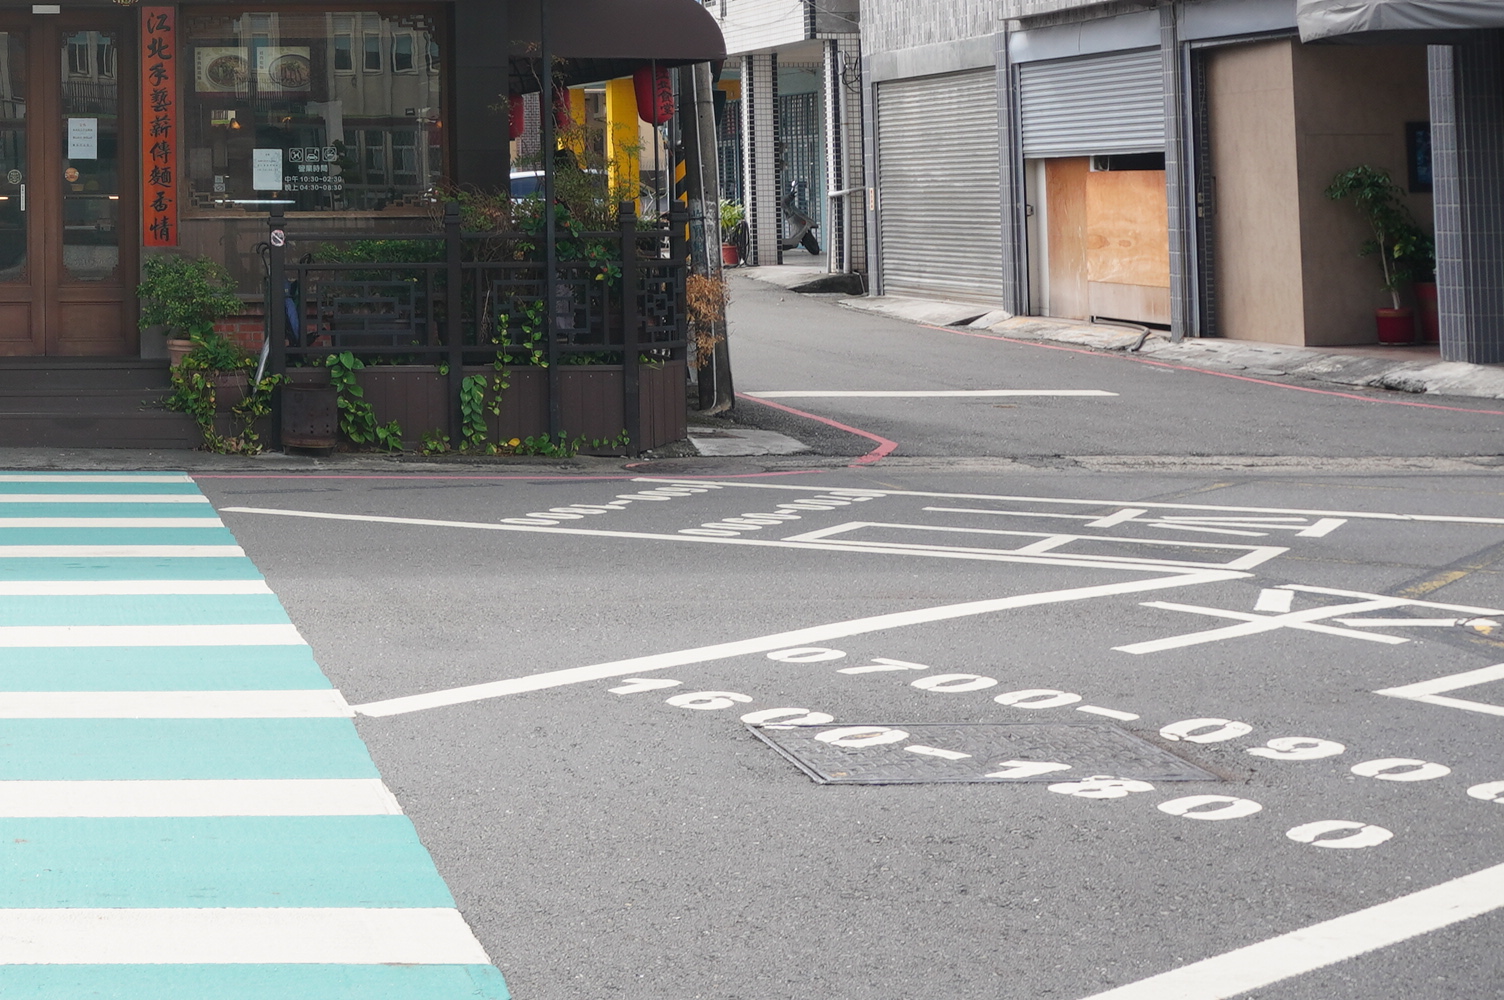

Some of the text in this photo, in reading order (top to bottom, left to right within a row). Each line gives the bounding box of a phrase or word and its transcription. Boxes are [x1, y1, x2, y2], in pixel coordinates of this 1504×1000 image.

[297, 164, 328, 173] 營業時間
[284, 175, 299, 183] 中午
[284, 183, 299, 191] 晚上
